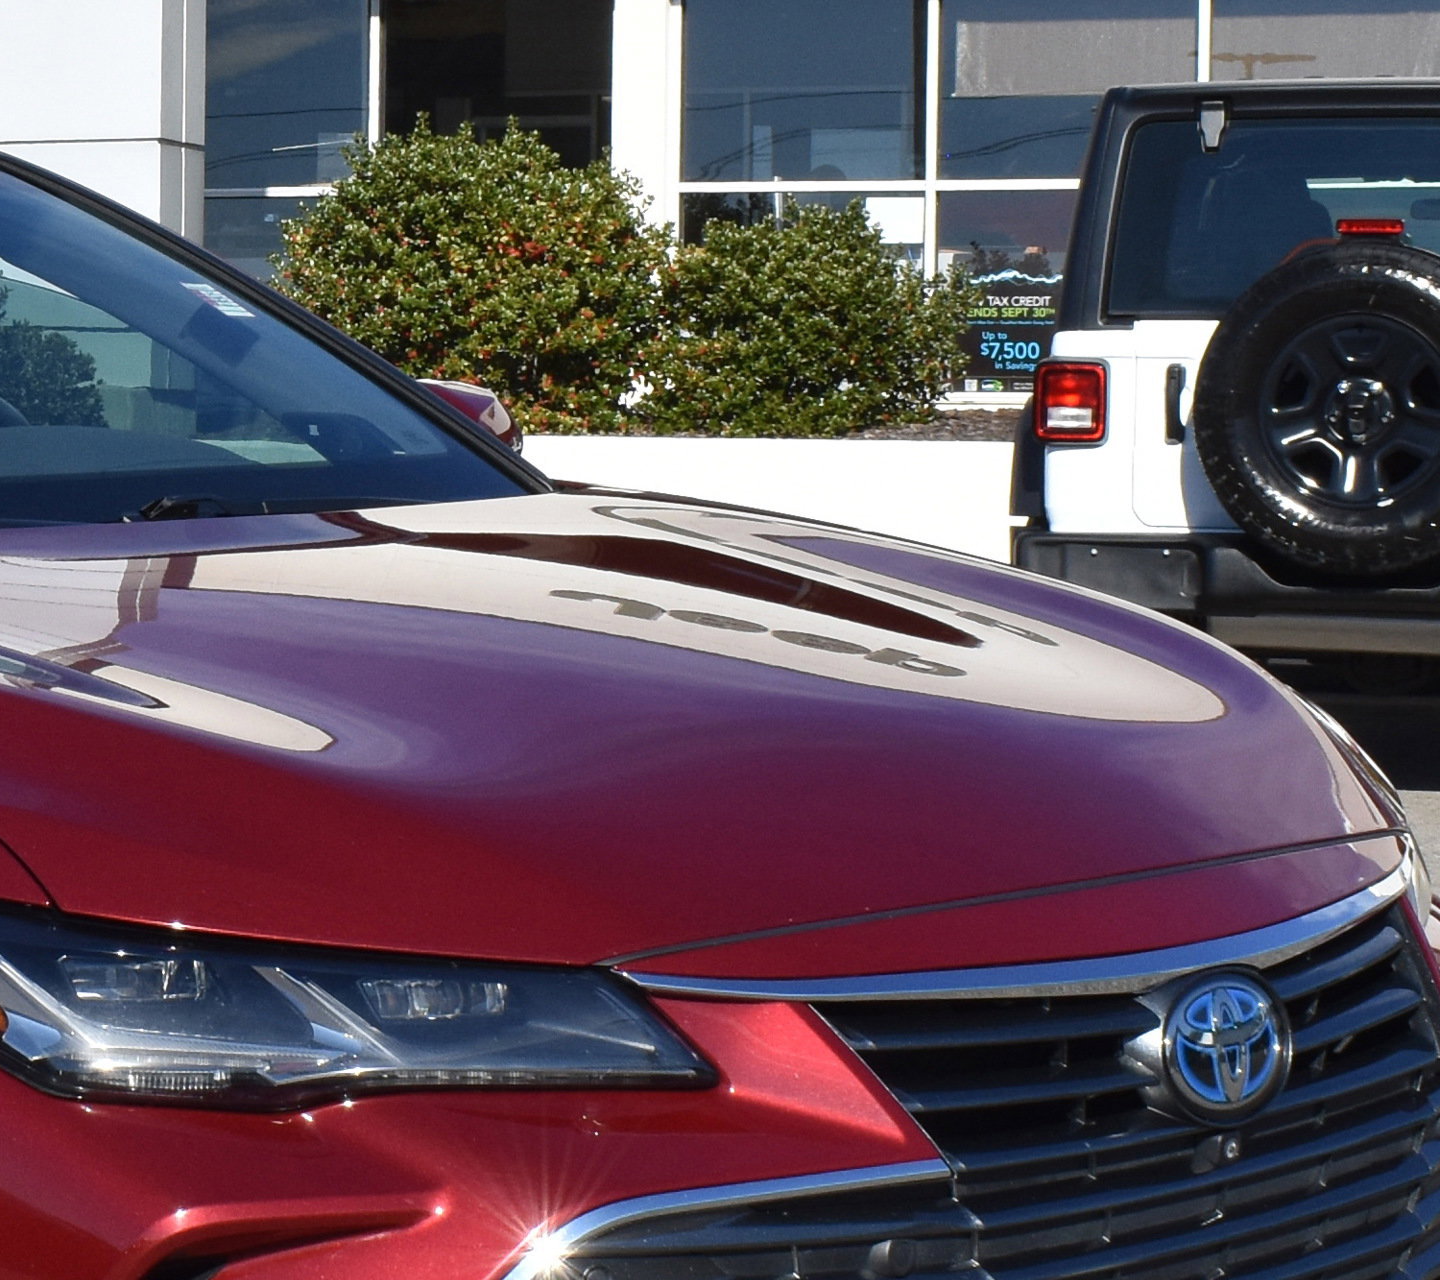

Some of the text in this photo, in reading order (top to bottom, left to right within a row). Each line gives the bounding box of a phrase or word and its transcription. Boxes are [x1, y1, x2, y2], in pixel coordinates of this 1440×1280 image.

[987, 295, 1010, 306] TAX
[1010, 295, 1052, 307] CREDIT
[966, 307, 998, 318] ENDS
[1001, 307, 1028, 318] SEPT
[982, 331, 1008, 341] Up to
[980, 341, 1040, 361] $7,500
[1005, 362, 1038, 372] Saving
